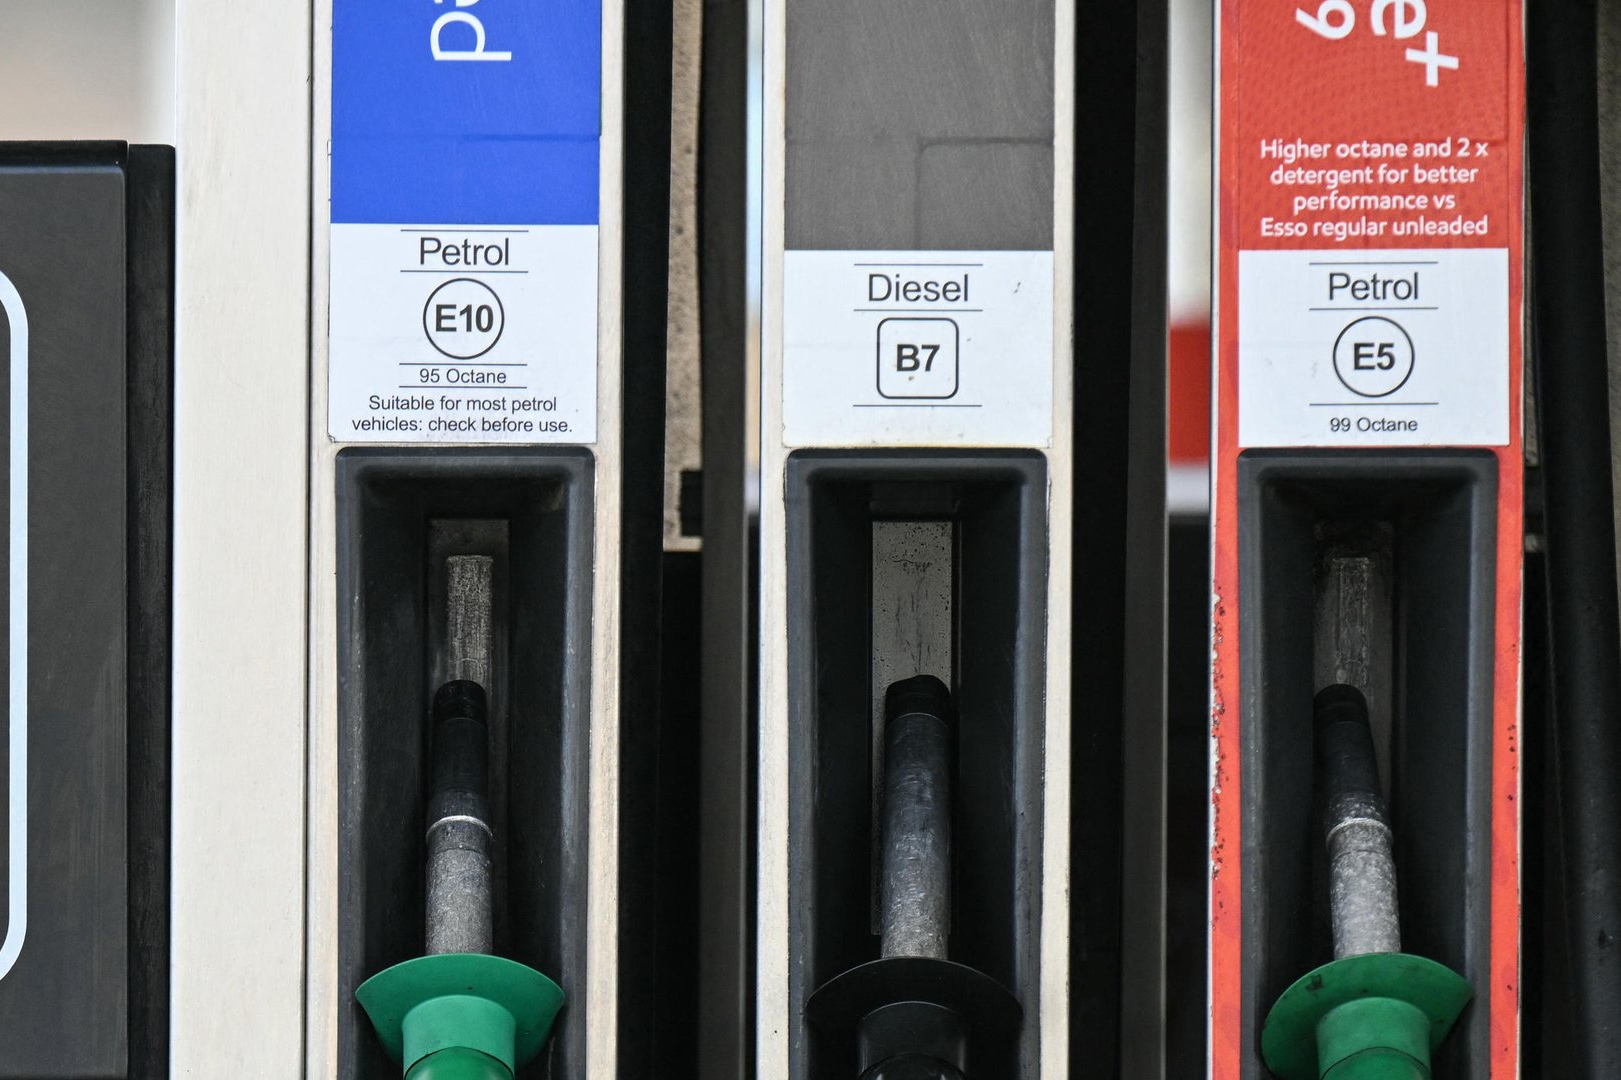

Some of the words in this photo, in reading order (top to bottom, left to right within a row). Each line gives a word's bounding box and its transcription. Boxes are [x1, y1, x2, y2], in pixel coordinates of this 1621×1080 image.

[1260, 138, 1331, 161] Higher
[1335, 140, 1408, 158] octane
[1413, 138, 1451, 157] and
[1457, 138, 1470, 157] 2
[1475, 143, 1489, 157] x
[1270, 165, 1373, 189] detergent
[1377, 165, 1410, 184] for
[1413, 165, 1478, 184] better
[1293, 191, 1428, 216] performance
[1432, 195, 1455, 210] vs
[1261, 218, 1307, 237] Esso
[1313, 217, 1387, 241] regular
[1392, 215, 1488, 236] unleaded
[419, 237, 510, 266] Petrol
[868, 273, 969, 302] Diesel
[1329, 272, 1419, 301] Petrol
[435, 304, 495, 334] E10
[896, 344, 940, 372] B7
[1353, 342, 1396, 371] E5
[419, 368, 440, 384] 95
[445, 368, 507, 384] Octane
[369, 395, 435, 412] Suitable
[439, 395, 462, 412] for
[466, 397, 506, 412] most
[511, 396, 558, 416] petrol
[351, 416, 423, 433] vehicles:
[428, 416, 476, 433] check
[480, 416, 534, 433] before
[538, 420, 573, 433] use.
[1330, 417, 1351, 432] 99
[1356, 417, 1418, 432] Octane
